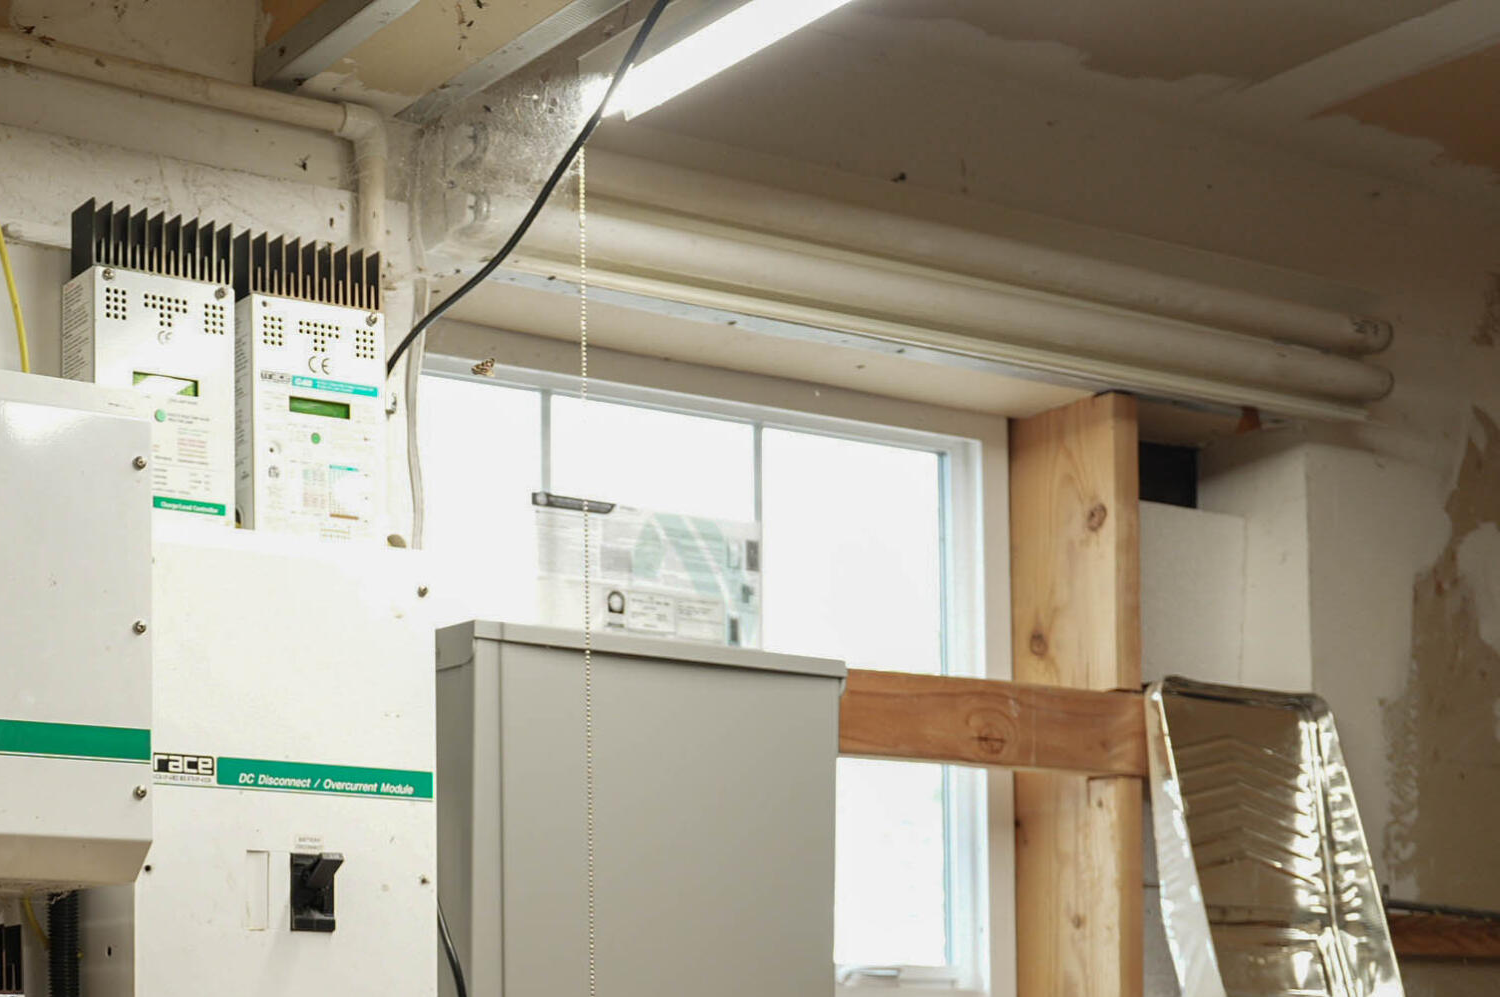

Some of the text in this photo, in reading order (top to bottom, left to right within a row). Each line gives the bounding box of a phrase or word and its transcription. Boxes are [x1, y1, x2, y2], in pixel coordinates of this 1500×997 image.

[153, 755, 214, 776] race
[239, 773, 254, 784] DC
[258, 773, 311, 788] Disconnect
[323, 779, 378, 793] Overcurrent
[381, 782, 414, 795] Module
